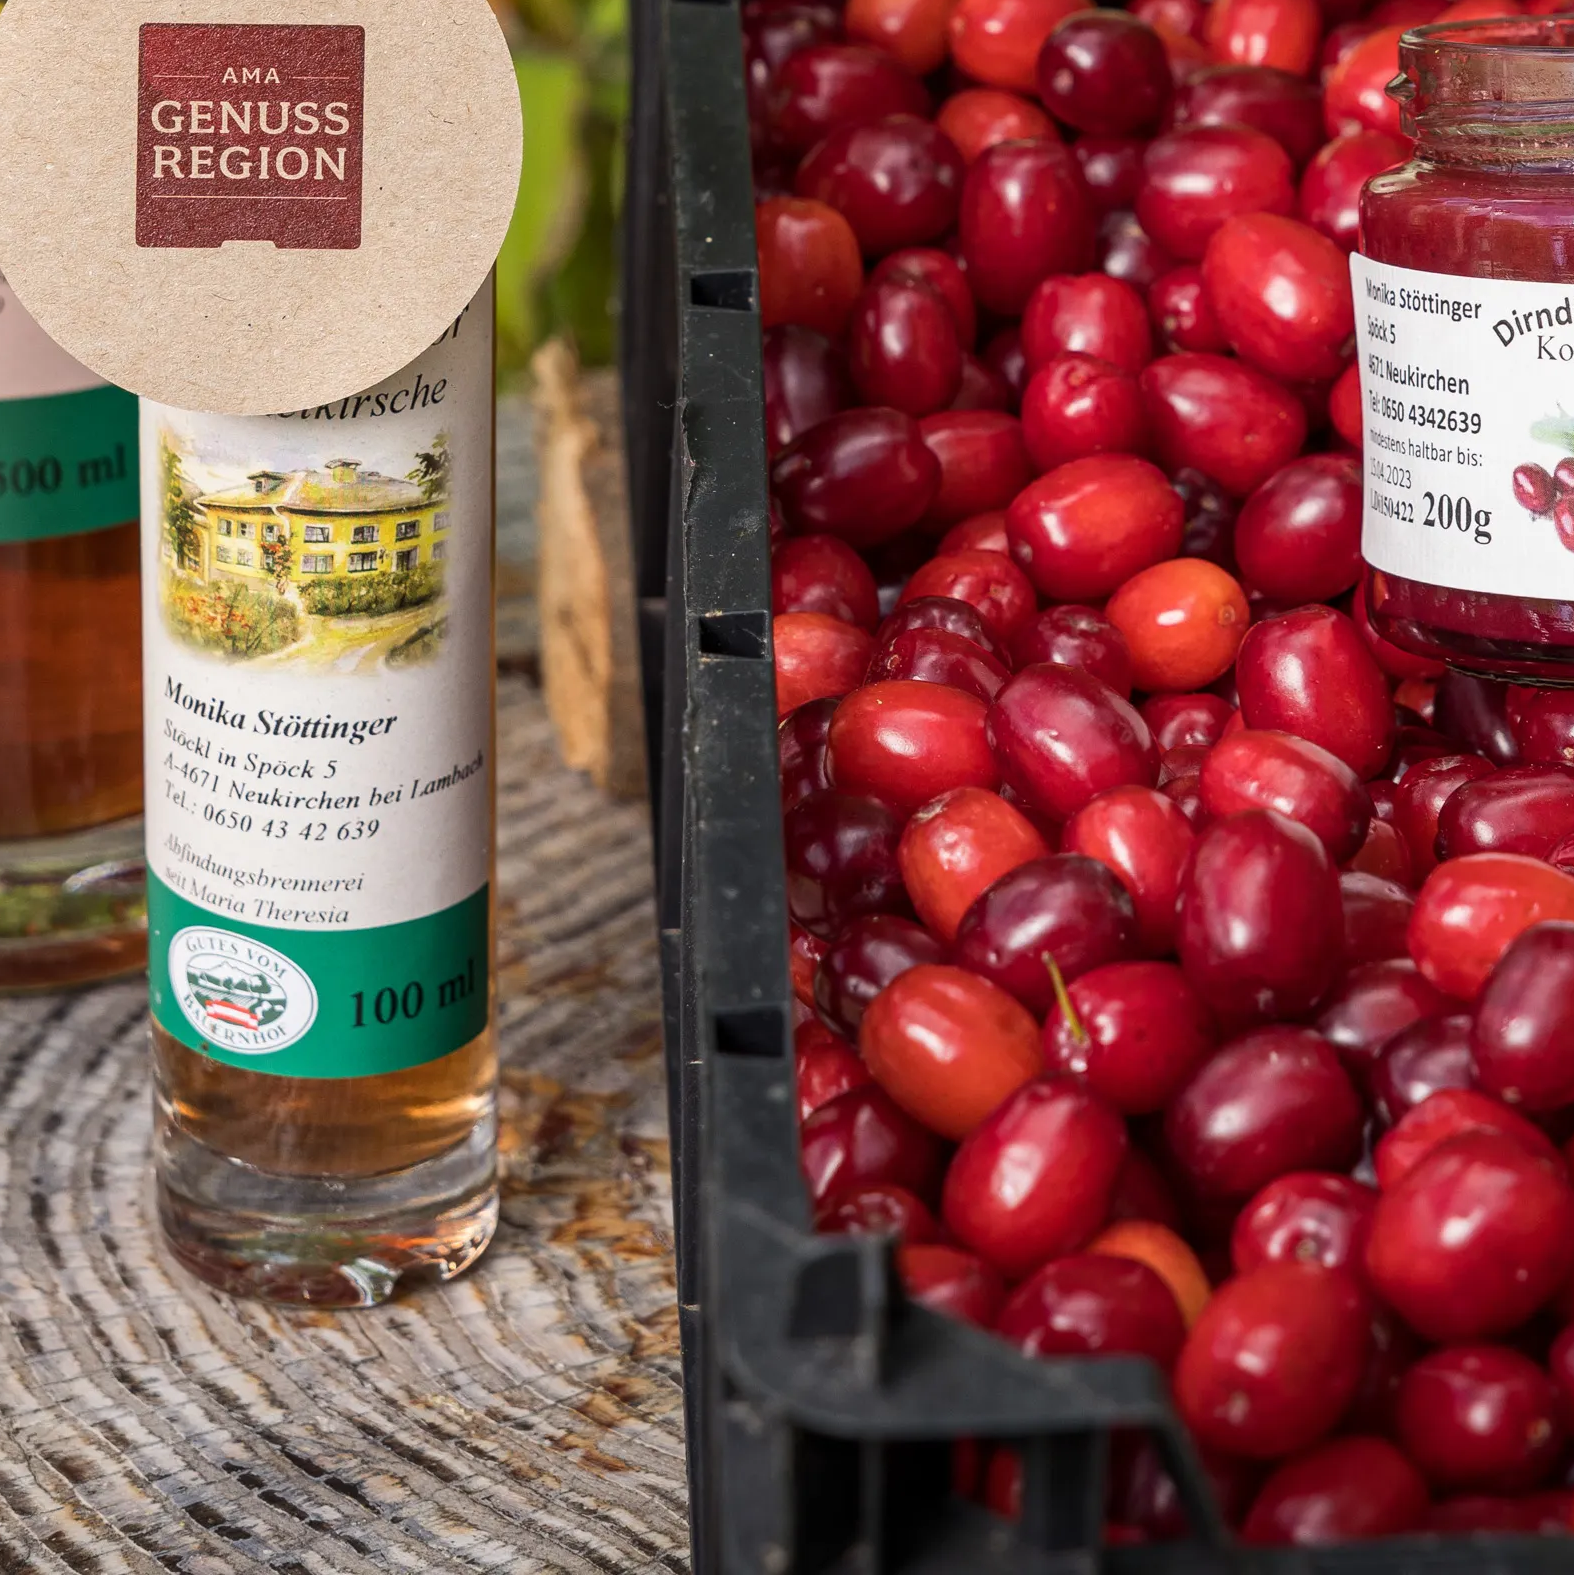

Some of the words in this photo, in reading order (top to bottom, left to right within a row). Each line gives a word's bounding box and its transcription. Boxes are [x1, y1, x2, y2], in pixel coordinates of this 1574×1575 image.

[221, 66, 282, 85] AMA
[150, 100, 351, 136] GENUSS
[151, 145, 347, 181] REGION
[1365, 277, 1396, 306] Monika
[1399, 287, 1482, 322] Stöttinger
[1367, 314, 1388, 342] Spöck
[1390, 324, 1396, 345] 5
[1386, 360, 1470, 395] Neukirchen
[1381, 396, 1405, 422] 0650
[1408, 404, 1482, 435] 4342639
[77, 441, 127, 489] ml
[1408, 438, 1453, 463] haltbar
[1457, 446, 1483, 467] bis:
[1422, 491, 1493, 545] 200g
[164, 675, 246, 730] Monika
[253, 709, 398, 745] Stöttinger
[164, 718, 211, 760] Stöckl
[218, 747, 237, 768] in
[244, 753, 315, 779] Spöck
[324, 760, 339, 779] 5
[164, 751, 220, 793] A-4671
[228, 780, 360, 810] Neukirchen
[369, 784, 405, 806] bei
[410, 749, 485, 799] Lambach
[164, 779, 197, 815] Tel.:
[204, 803, 253, 833] 0650
[261, 819, 288, 839] 43
[298, 822, 327, 842] 42
[336, 818, 380, 842] 639
[164, 832, 366, 893] Abfindungsbrennerei
[165, 866, 188, 890] seit
[189, 873, 245, 915] Maria
[253, 898, 351, 924] Theresia
[185, 935, 239, 955] GUTES
[246, 947, 288, 979] VOM
[352, 979, 425, 1029] 100
[437, 959, 476, 1009] ml
